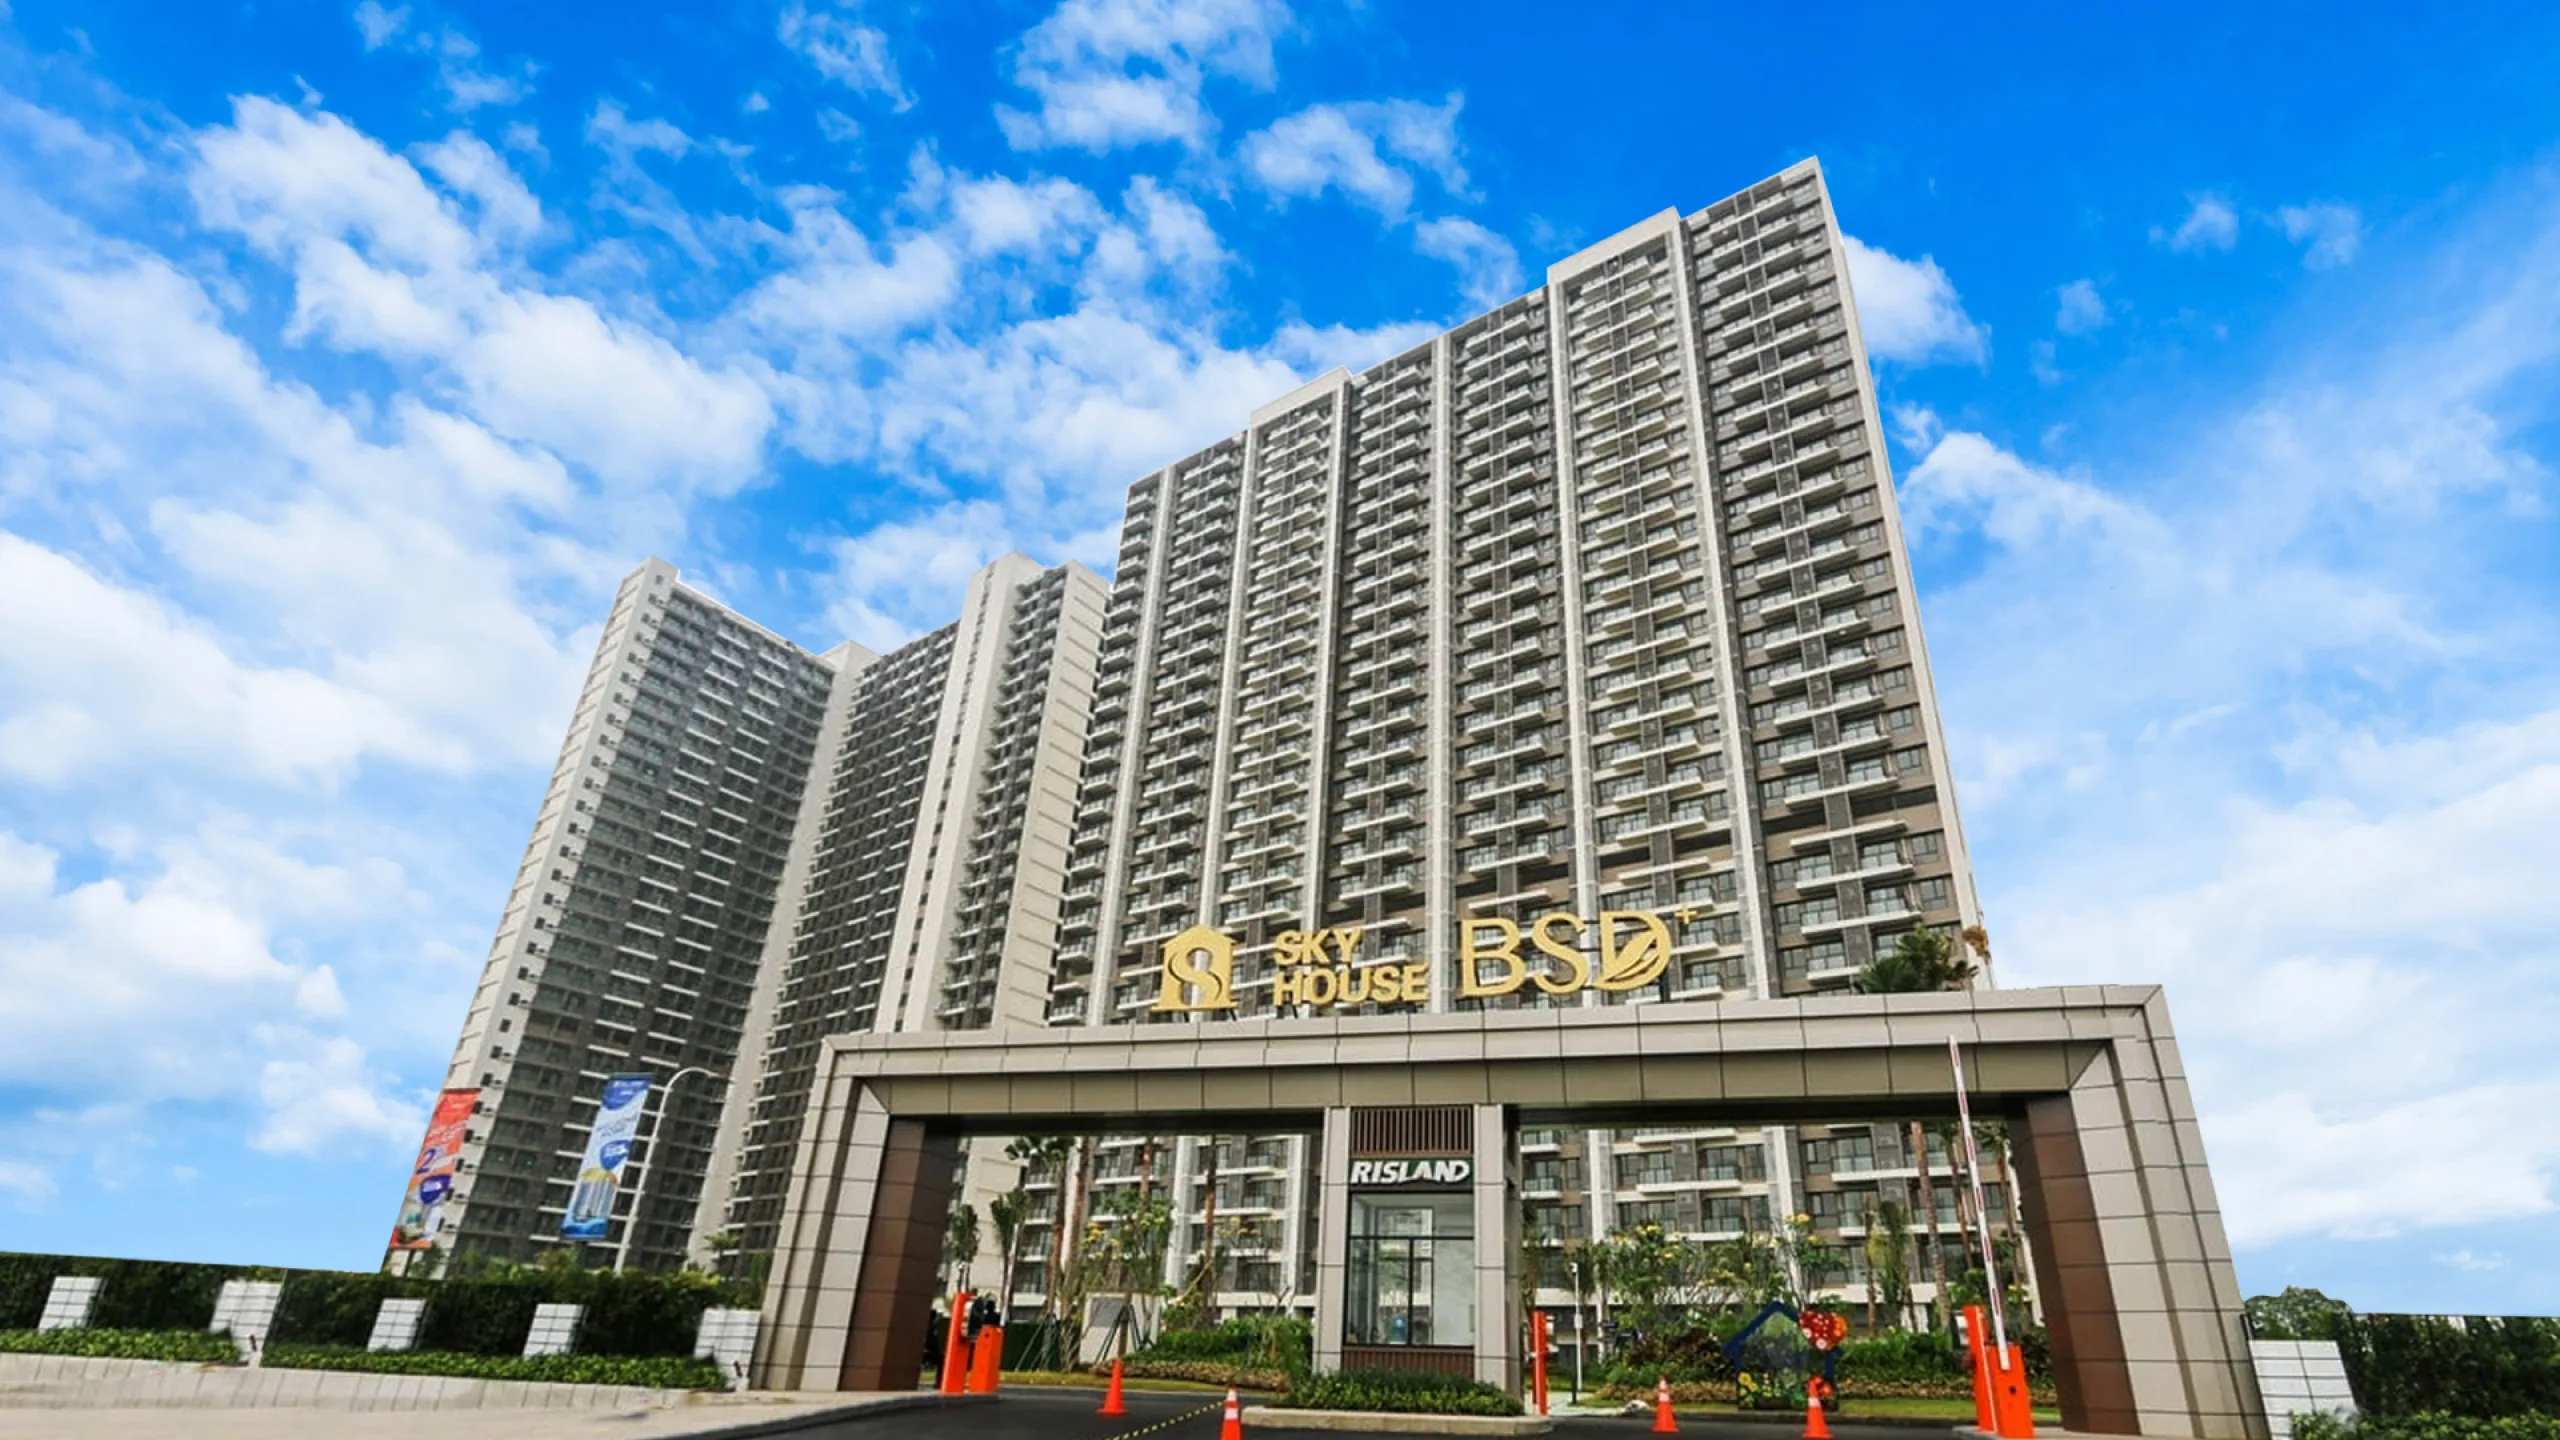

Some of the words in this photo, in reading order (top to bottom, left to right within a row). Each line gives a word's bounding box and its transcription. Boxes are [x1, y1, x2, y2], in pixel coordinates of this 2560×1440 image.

[1273, 927, 1365, 966] SKY
[1272, 963, 1430, 1007] HOUSE
[1350, 1160, 1470, 1185] RISLAND
